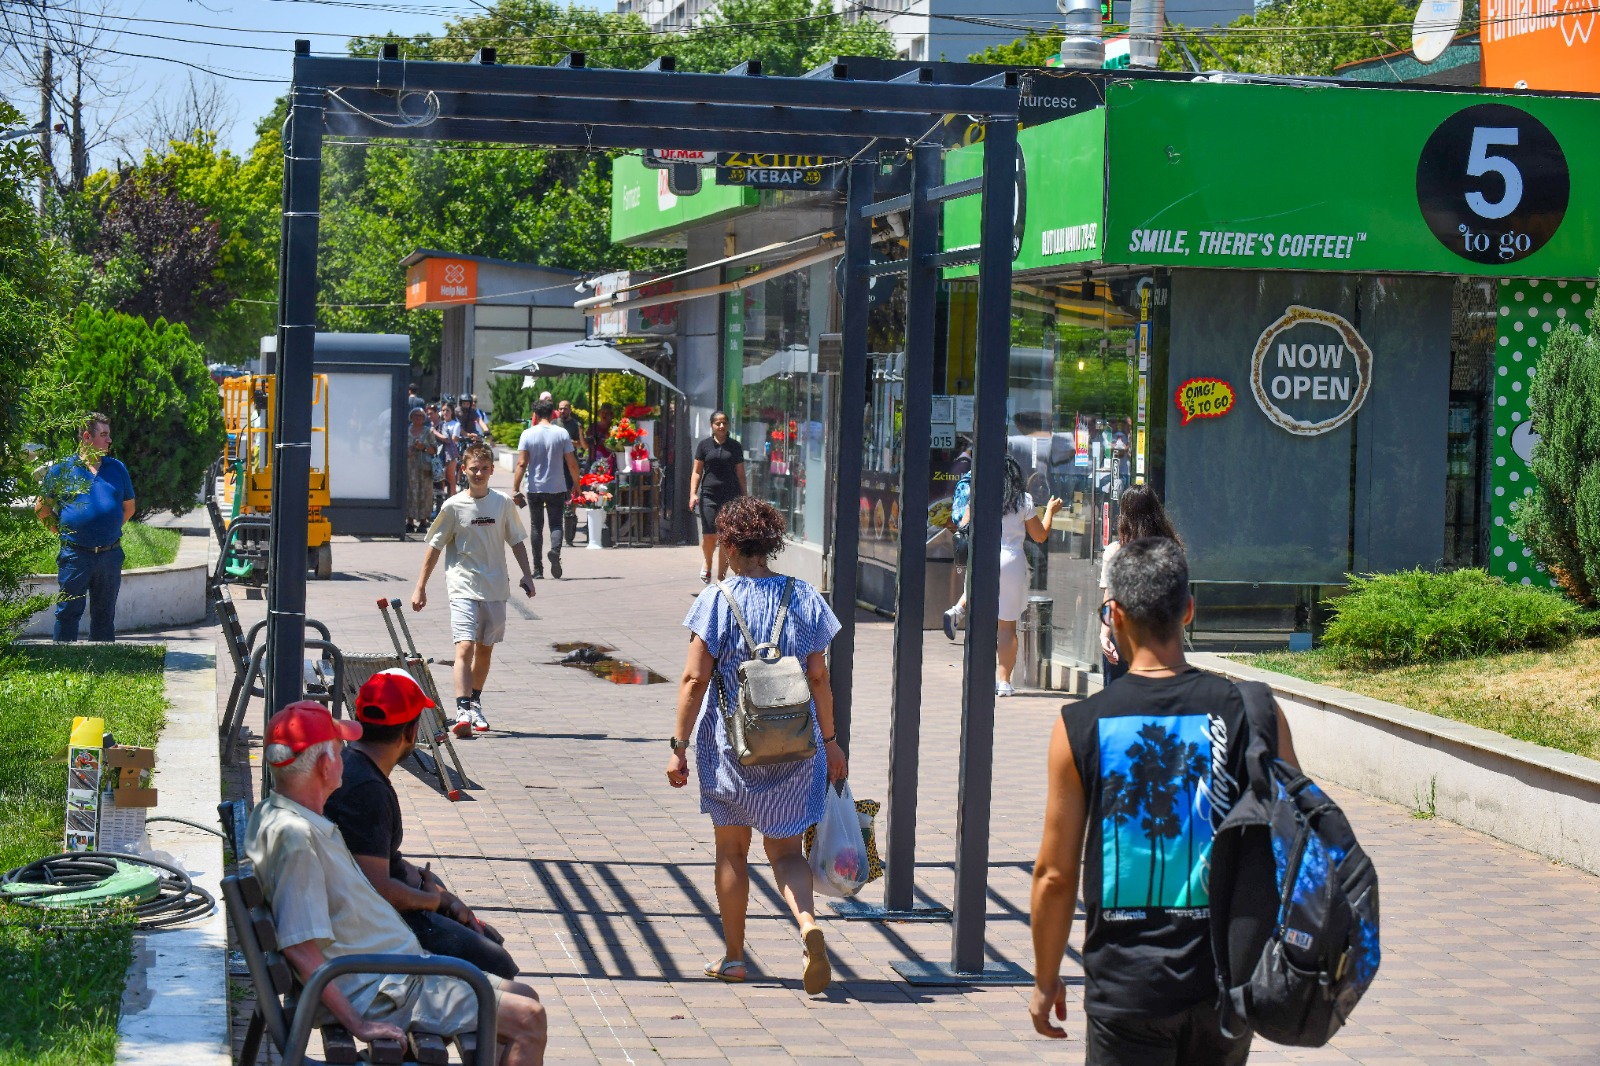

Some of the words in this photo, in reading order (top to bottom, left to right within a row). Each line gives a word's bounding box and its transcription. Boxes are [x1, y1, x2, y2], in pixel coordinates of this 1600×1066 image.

[1022, 95, 1077, 109] turcesc
[747, 170, 803, 184] KEBAP
[1465, 127, 1523, 219] 5
[1129, 229, 1190, 256] SMILE,
[1198, 231, 1275, 256] THERE'S
[1462, 226, 1490, 252] to
[1499, 231, 1531, 260] go
[1277, 344, 1343, 368] NOW
[1186, 383, 1215, 399] OMG!
[1271, 376, 1350, 400] OPEN
[1188, 405, 1195, 415] 5
[1198, 400, 1211, 412] TO
[1214, 395, 1229, 409] GO
[931, 437, 952, 447] 015
